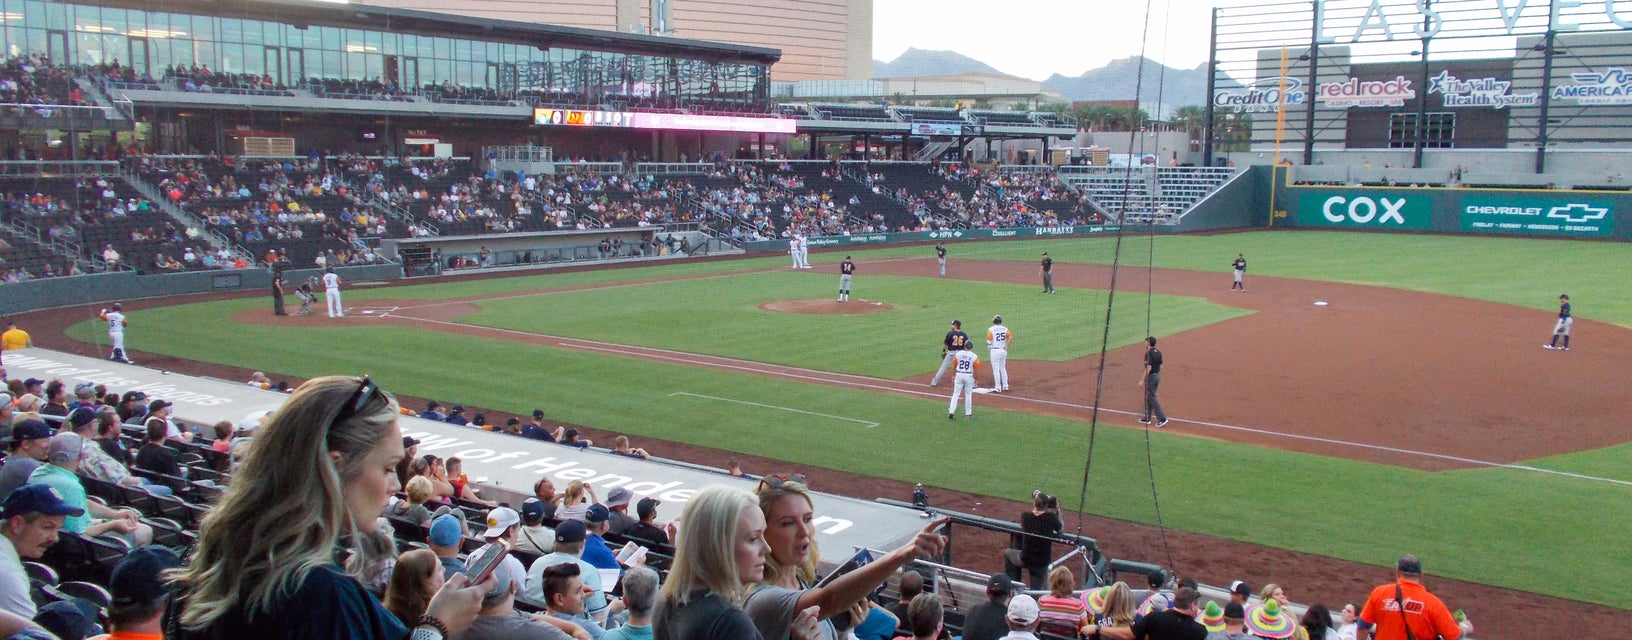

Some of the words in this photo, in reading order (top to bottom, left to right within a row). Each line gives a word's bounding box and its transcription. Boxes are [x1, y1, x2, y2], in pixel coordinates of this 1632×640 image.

[1316, 0, 1443, 43] LAS
[1320, 81, 1355, 96] red
[1361, 78, 1409, 95] rock
[1447, 81, 1469, 91] The
[1469, 80, 1506, 93] Valley
[1554, 86, 1622, 96] AMERICA
[1446, 94, 1491, 105] Health
[1494, 94, 1534, 107] System
[1323, 196, 1406, 224] COX
[1466, 206, 1543, 215] CHEVROLET
[939, 230, 953, 238] HPN
[996, 332, 1006, 341] 25
[959, 360, 970, 370] 28
[453, 448, 531, 464] of
